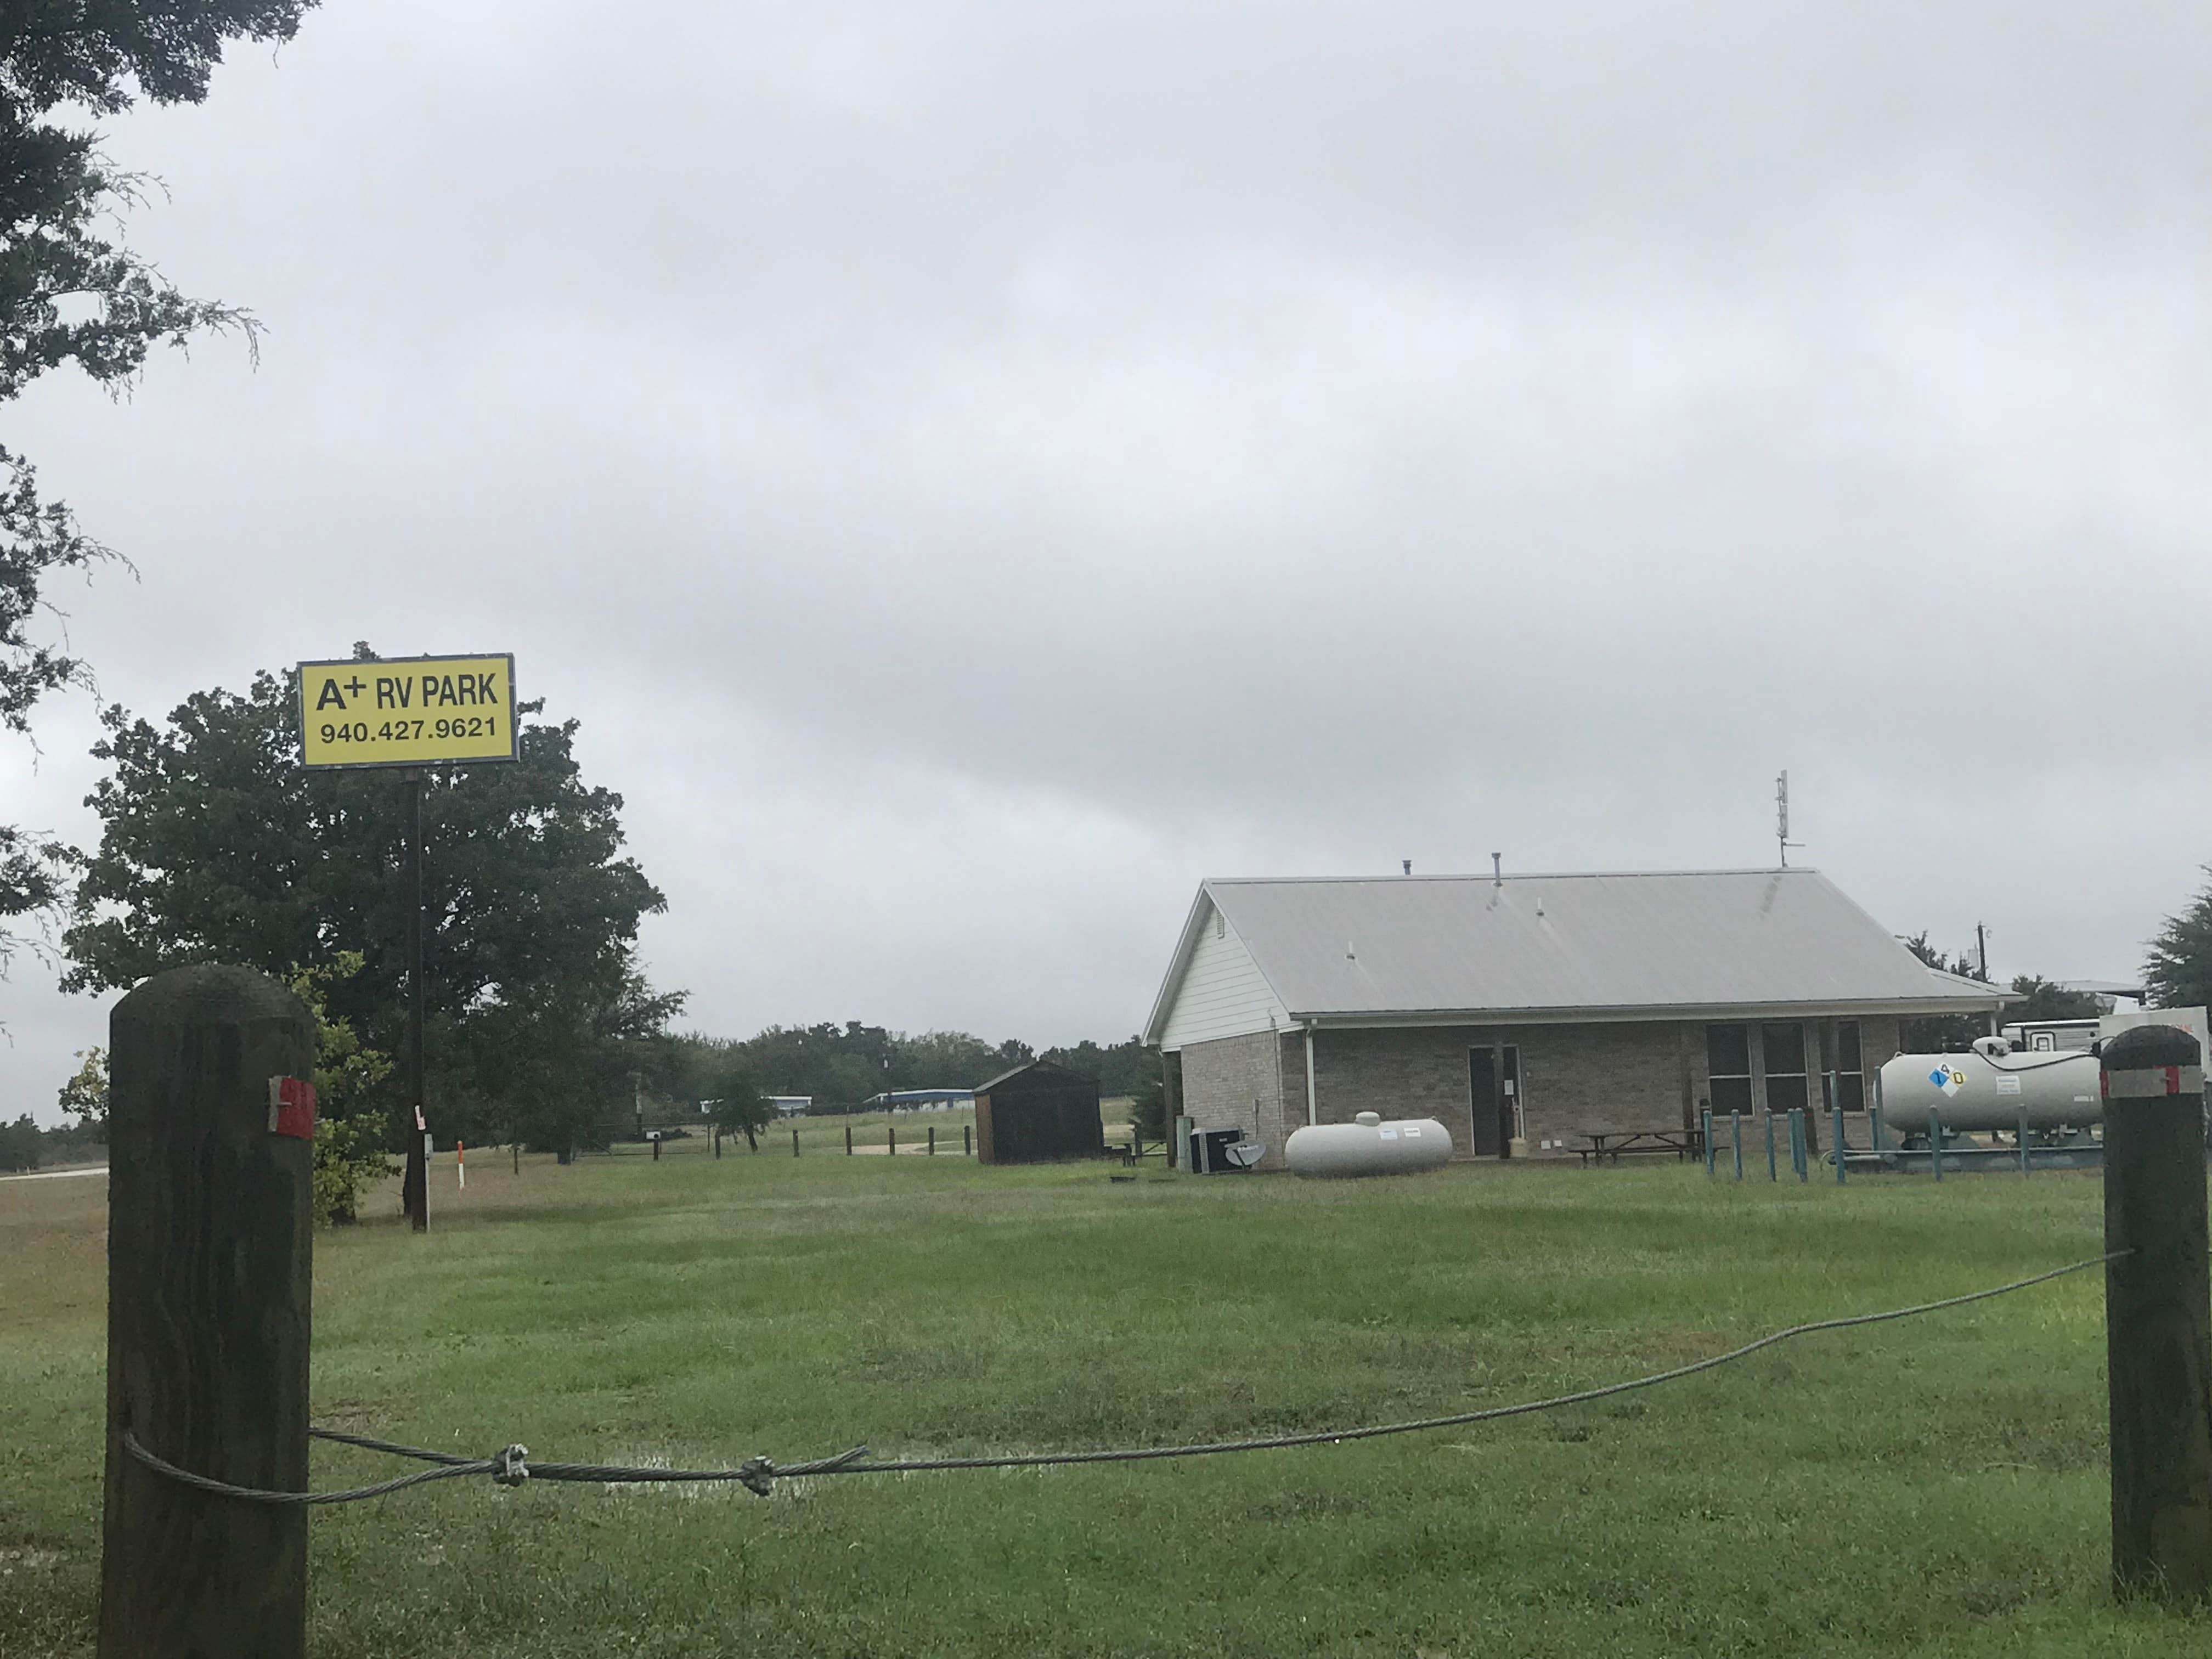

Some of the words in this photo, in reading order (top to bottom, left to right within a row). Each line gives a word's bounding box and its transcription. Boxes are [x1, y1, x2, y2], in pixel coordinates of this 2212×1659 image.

[316, 675, 367, 710] A+
[376, 676, 413, 709] RV
[422, 673, 498, 707] PARK
[320, 716, 495, 744] 940.427.9621
[1941, 1064, 1950, 1074] 4
[1935, 1072, 1942, 1084] 1
[1953, 1071, 1963, 1084] 0
